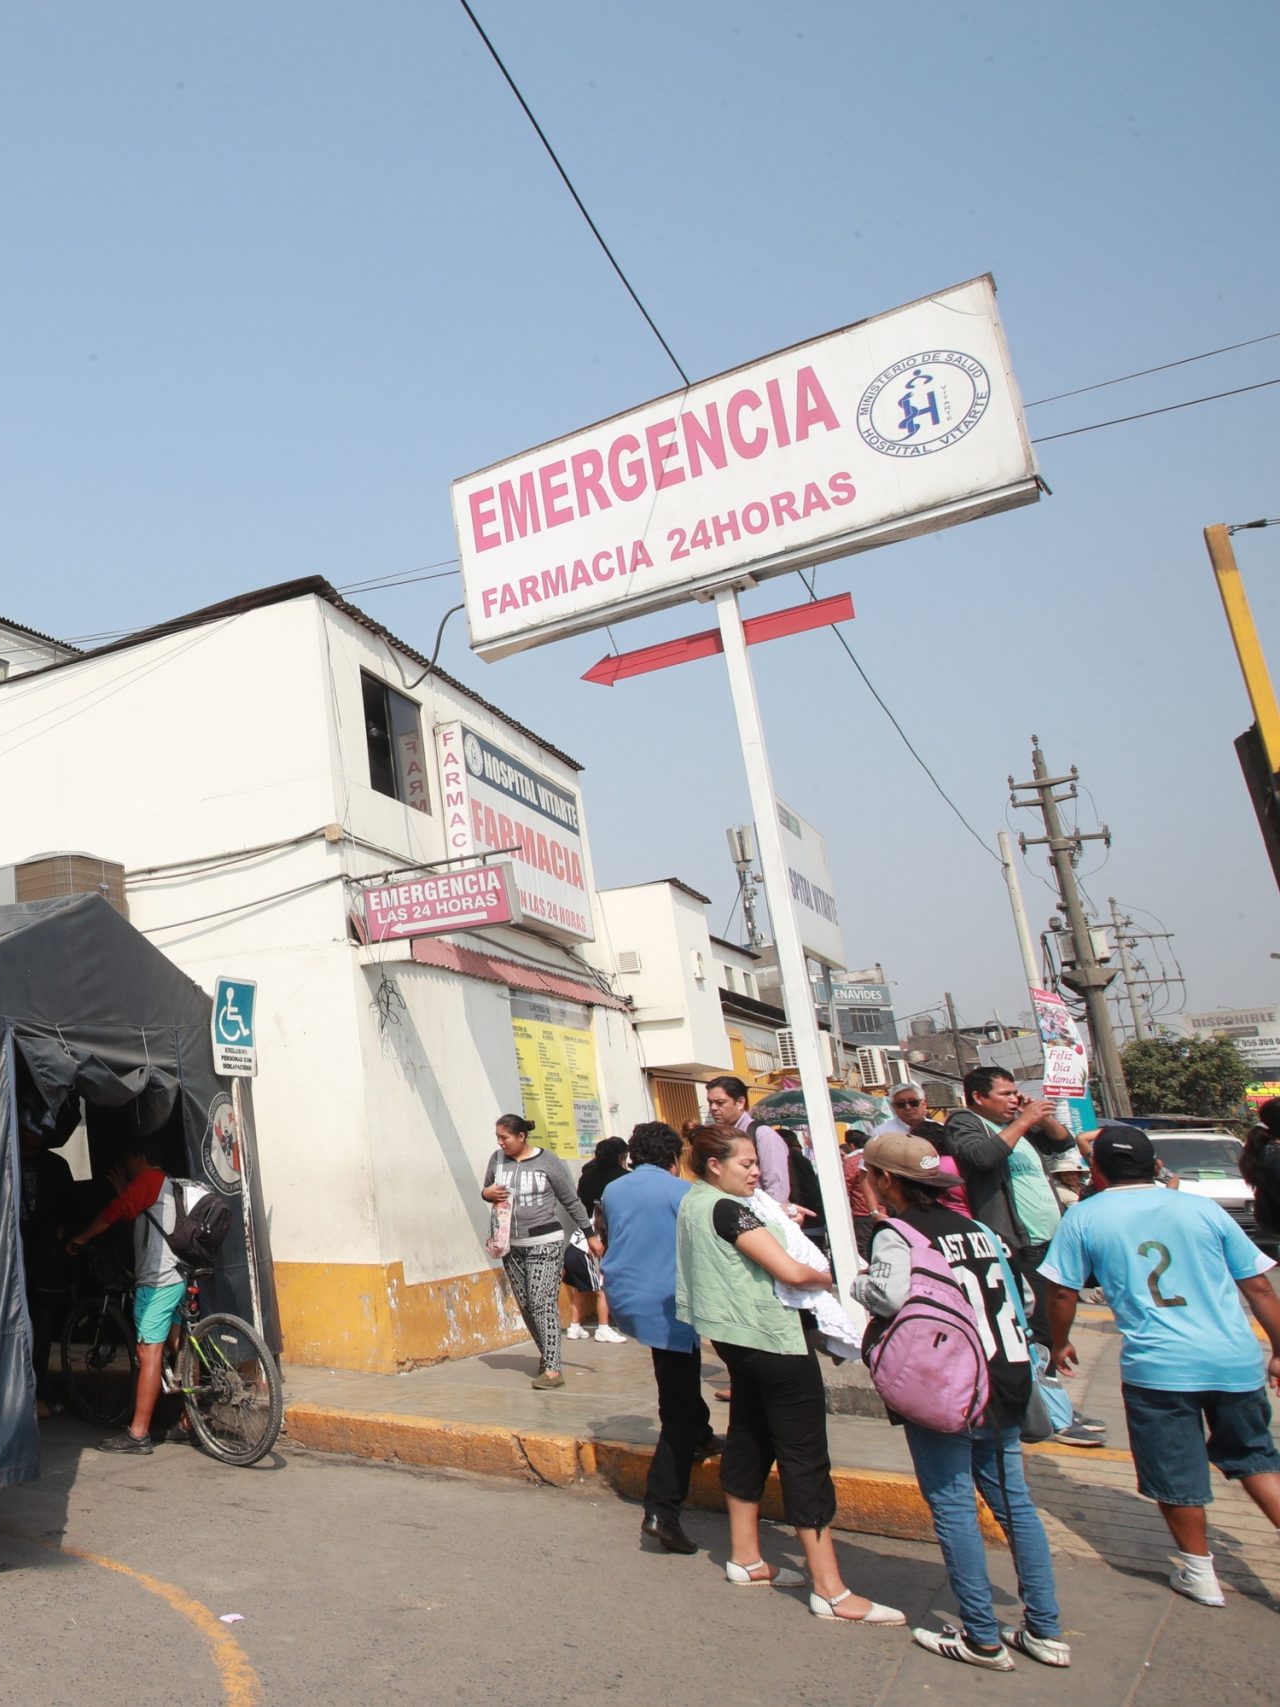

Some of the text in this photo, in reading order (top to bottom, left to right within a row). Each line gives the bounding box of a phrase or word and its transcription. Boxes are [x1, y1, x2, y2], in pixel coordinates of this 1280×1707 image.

[859, 352, 984, 416] MINISTERIO DE SALUD
[862, 390, 988, 456] HOSPITAL VITARTE
[468, 365, 841, 554] EMERGENCIA
[481, 471, 856, 618] FARMACIA 24HORAS
[441, 731, 468, 868] FARMACI
[482, 750, 539, 806] HOSPITAL
[536, 780, 578, 828] VITARTE
[470, 798, 585, 892] FARMACIA
[370, 870, 502, 911] EMERGENCIA
[376, 893, 498, 925] LAS 24 HORAS
[788, 866, 815, 911] SPITAL
[528, 892, 546, 917] LAS
[547, 899, 559, 922] 24
[559, 905, 587, 934] HORAS
[833, 989, 882, 1000] ENAVIDES
[1191, 1012, 1275, 1028] DISPONIBLE
[220, 1054, 243, 1063] PERSONAS
[1048, 1050, 1073, 1061] Feliz
[1070, 1106, 1083, 1135] ovistar
[1137, 1240, 1188, 1308] 2
